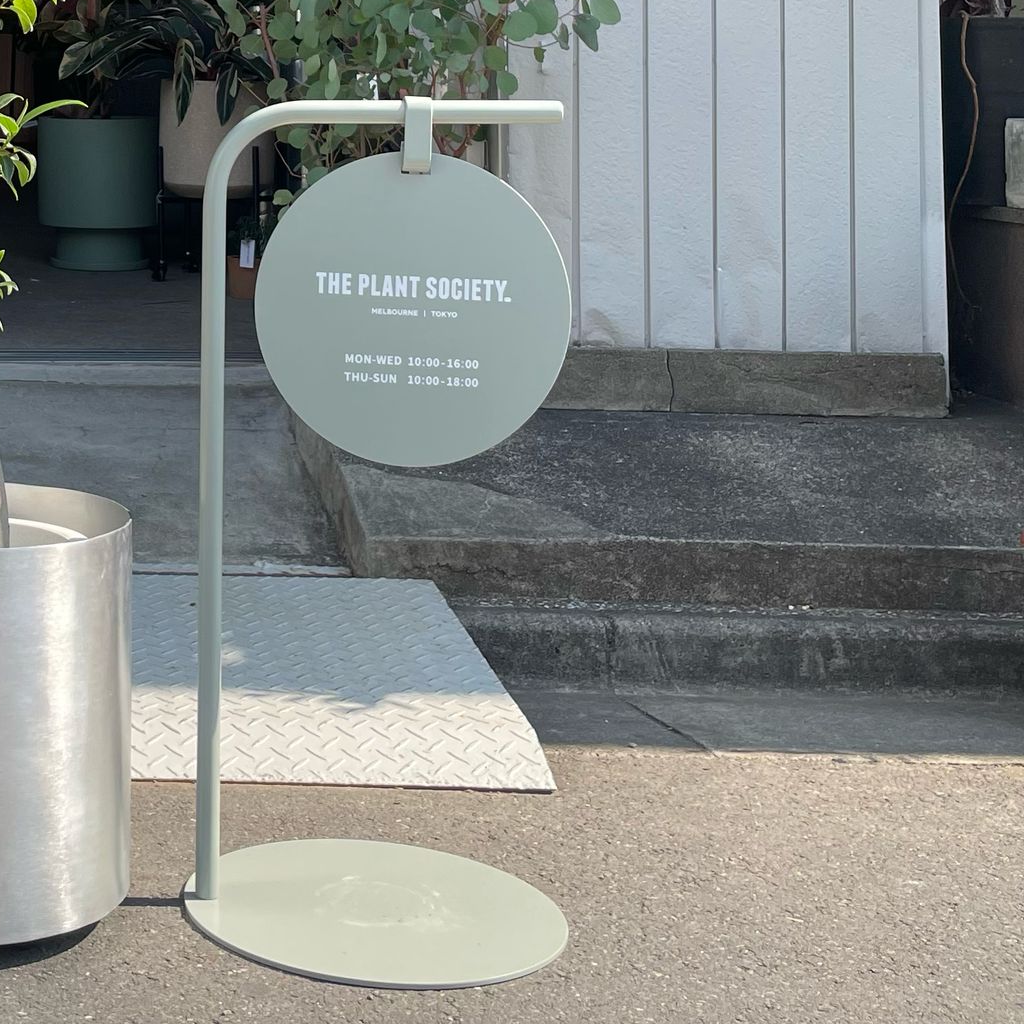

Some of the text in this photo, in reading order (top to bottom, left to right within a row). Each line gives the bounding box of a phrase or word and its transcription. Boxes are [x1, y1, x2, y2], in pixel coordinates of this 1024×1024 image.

[316, 272, 511, 302] THE PLANT SOCIETY.
[371, 307, 458, 319] MELBOURNE TOKYO
[344, 353, 403, 366] MON-WED
[343, 371, 397, 384] THU-SUN
